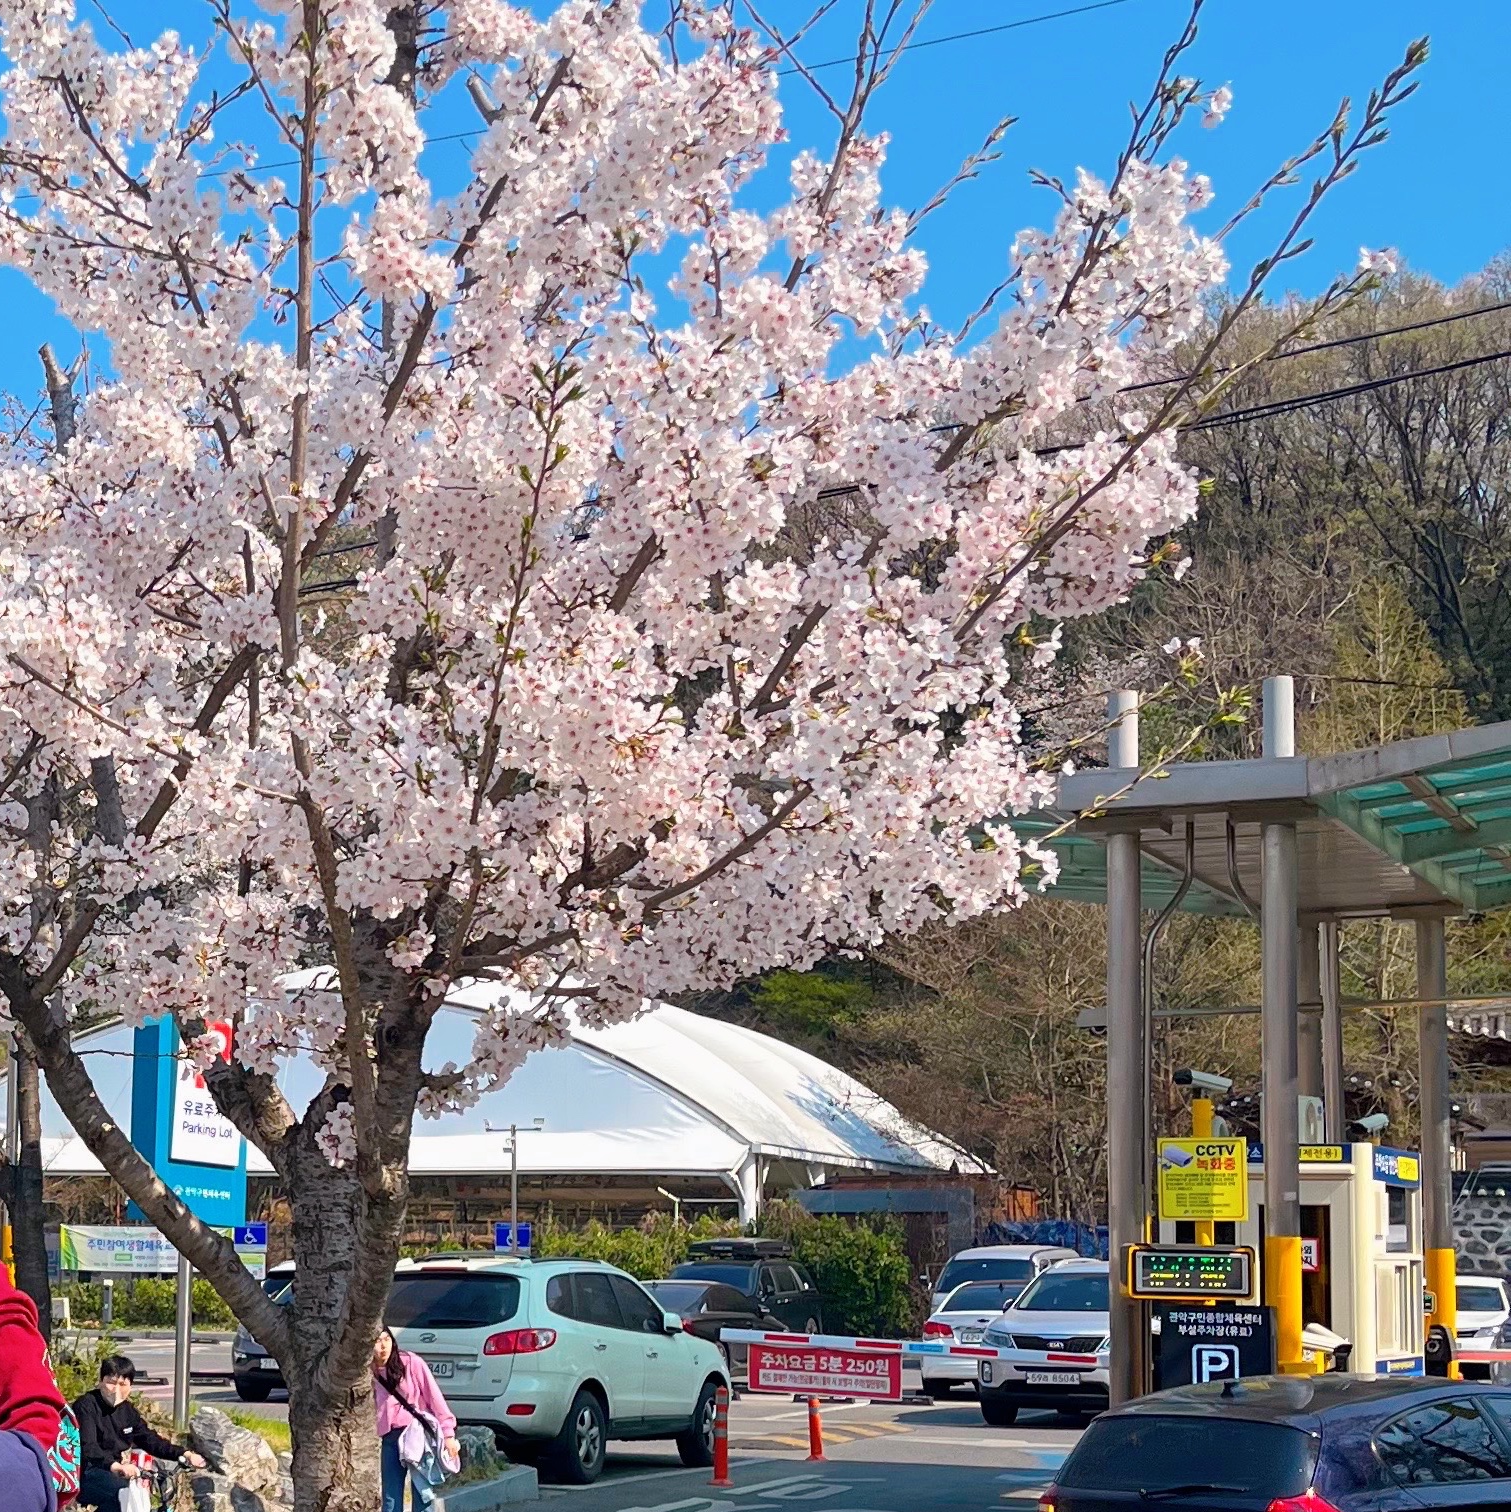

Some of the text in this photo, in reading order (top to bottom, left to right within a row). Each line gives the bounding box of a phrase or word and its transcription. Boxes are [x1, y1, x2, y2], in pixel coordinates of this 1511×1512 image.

[182, 1121, 232, 1139] Parking Lot
[1195, 1144, 1235, 1157] CCTV
[1196, 1157, 1236, 1171] 녹화중
[760, 1351, 890, 1376] 주차요금 5분 250원
